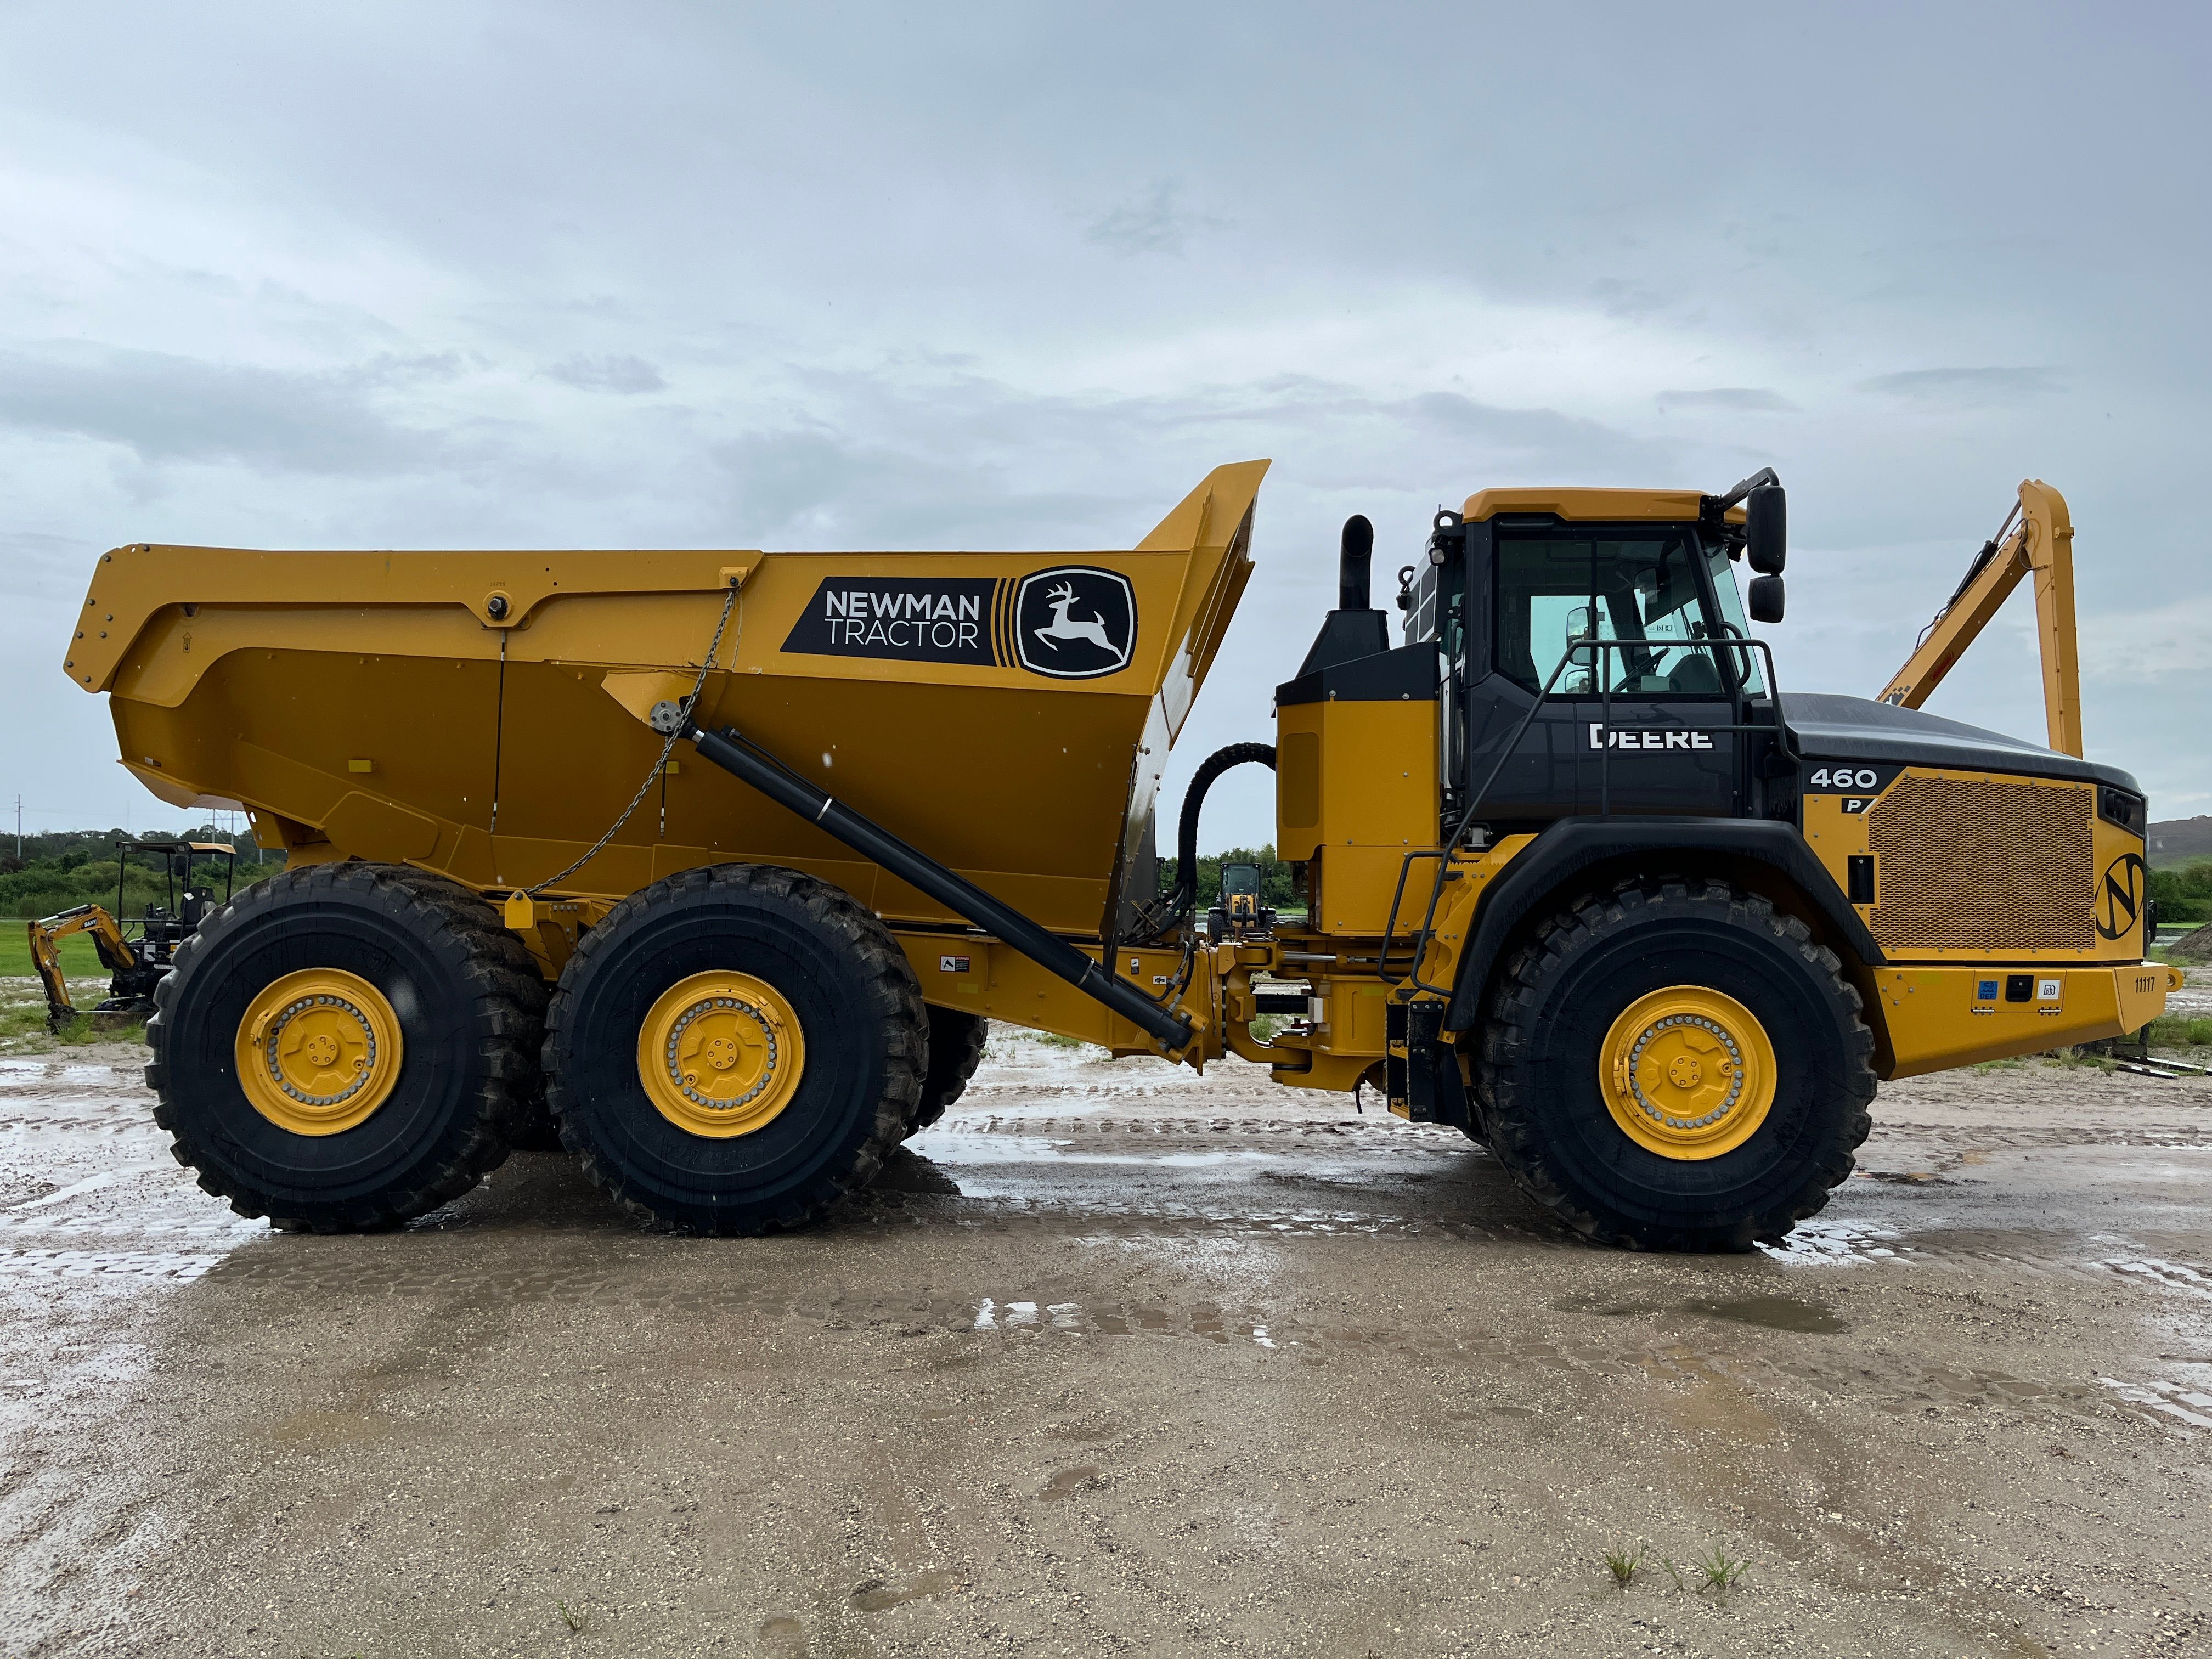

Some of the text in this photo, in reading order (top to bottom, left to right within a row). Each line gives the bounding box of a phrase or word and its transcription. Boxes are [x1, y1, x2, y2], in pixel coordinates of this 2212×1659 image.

[826, 591, 979, 621] NEWMAN
[825, 618, 978, 648] TRACTOR
[1590, 723, 1713, 748] DEERE
[1810, 769, 1877, 788] 460
[1847, 799, 1861, 812] P
[2135, 976, 2155, 993] 11117
